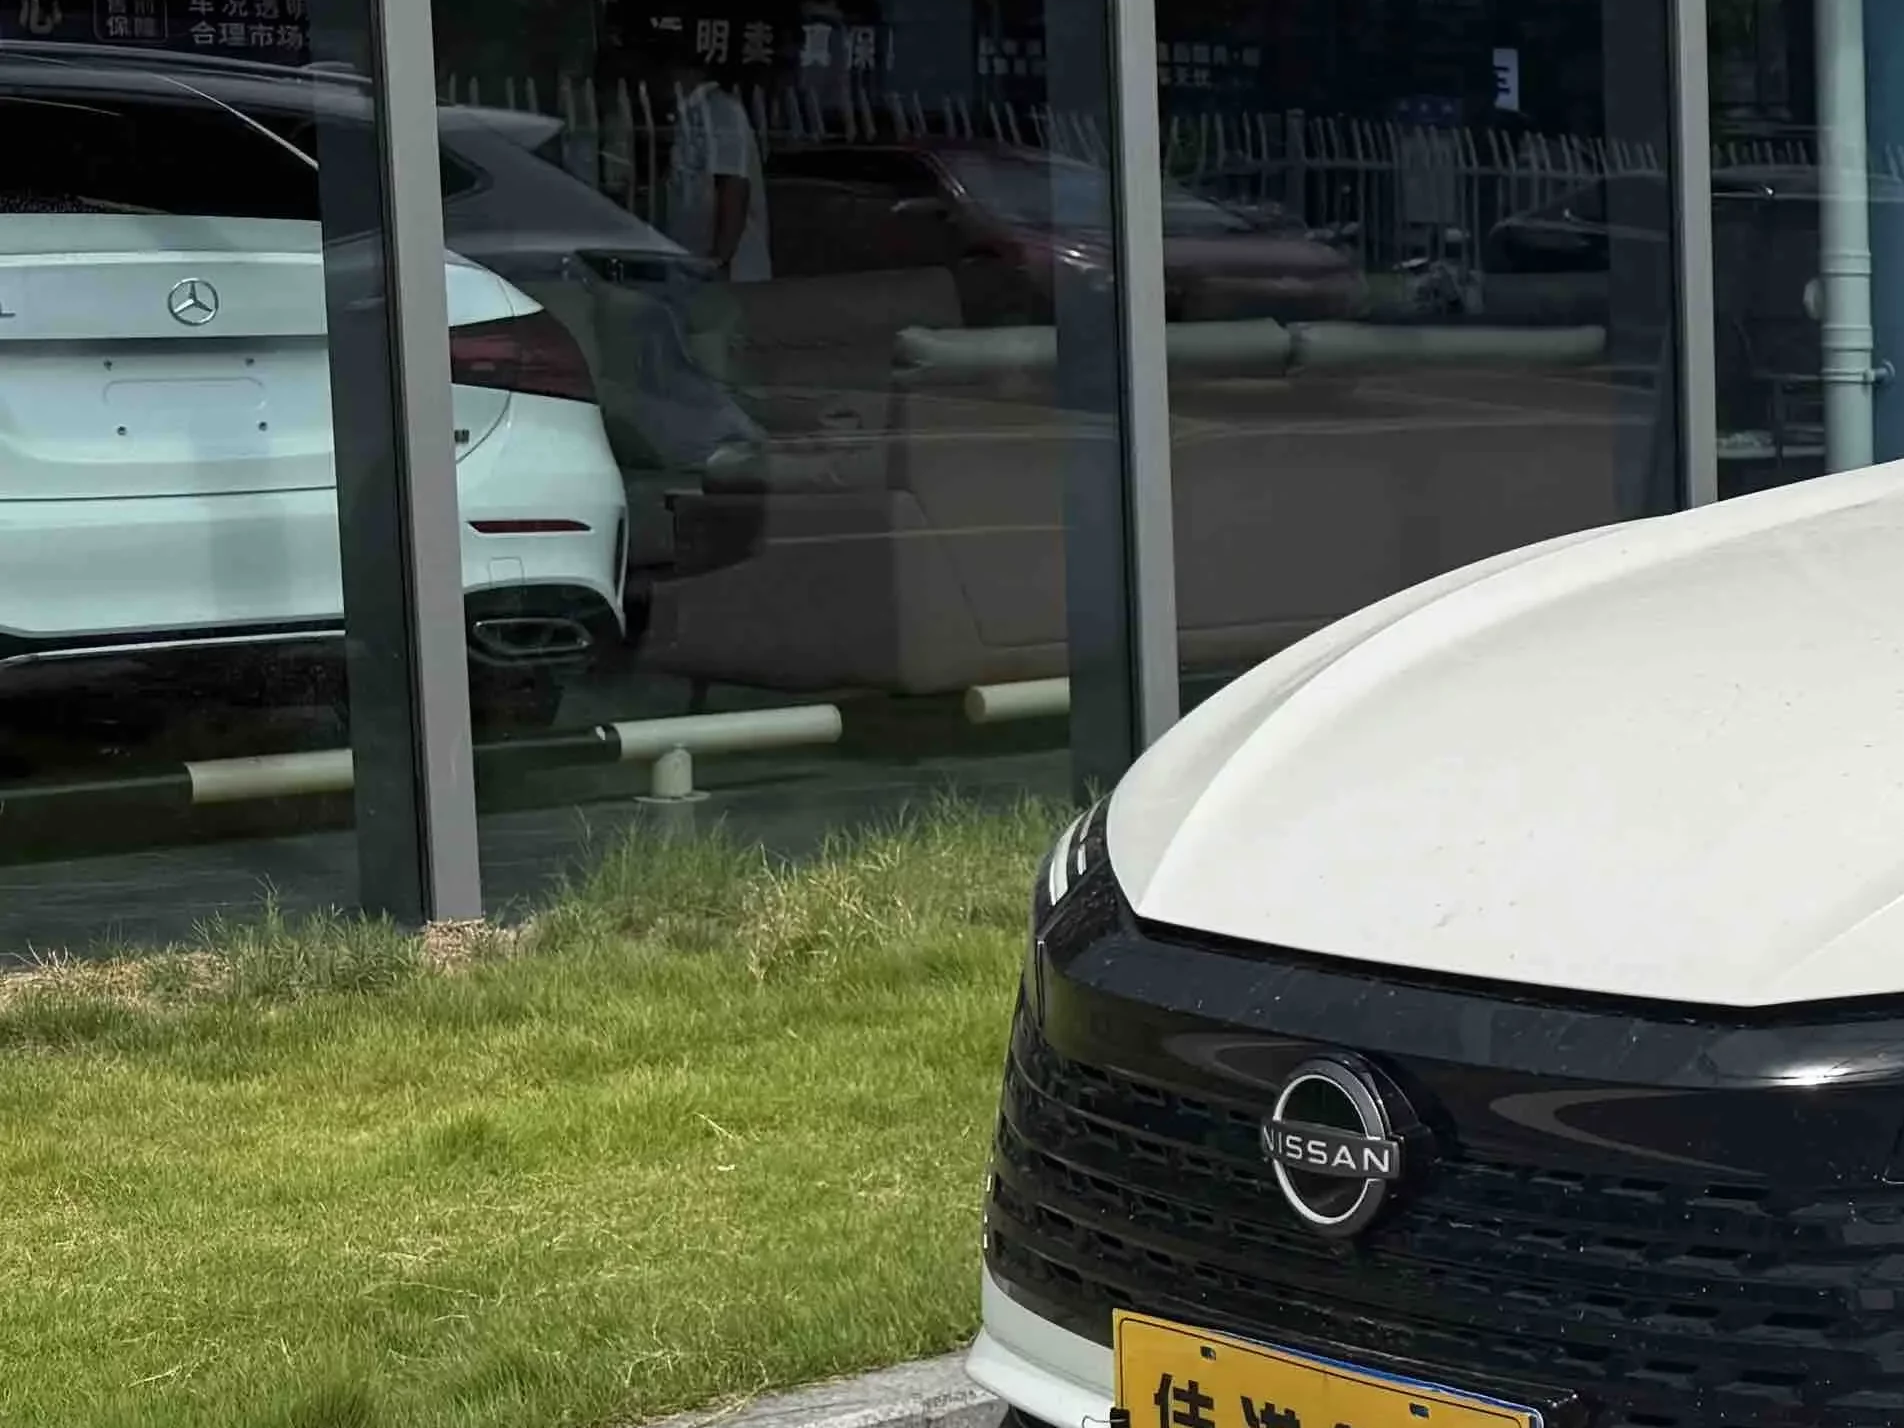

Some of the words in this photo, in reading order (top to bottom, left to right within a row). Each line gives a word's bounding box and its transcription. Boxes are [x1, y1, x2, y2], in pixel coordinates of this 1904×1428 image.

[188, 20, 310, 51] 合理市场
[800, 21, 897, 72] 真保
[1262, 1124, 1391, 1174] NISSAN
